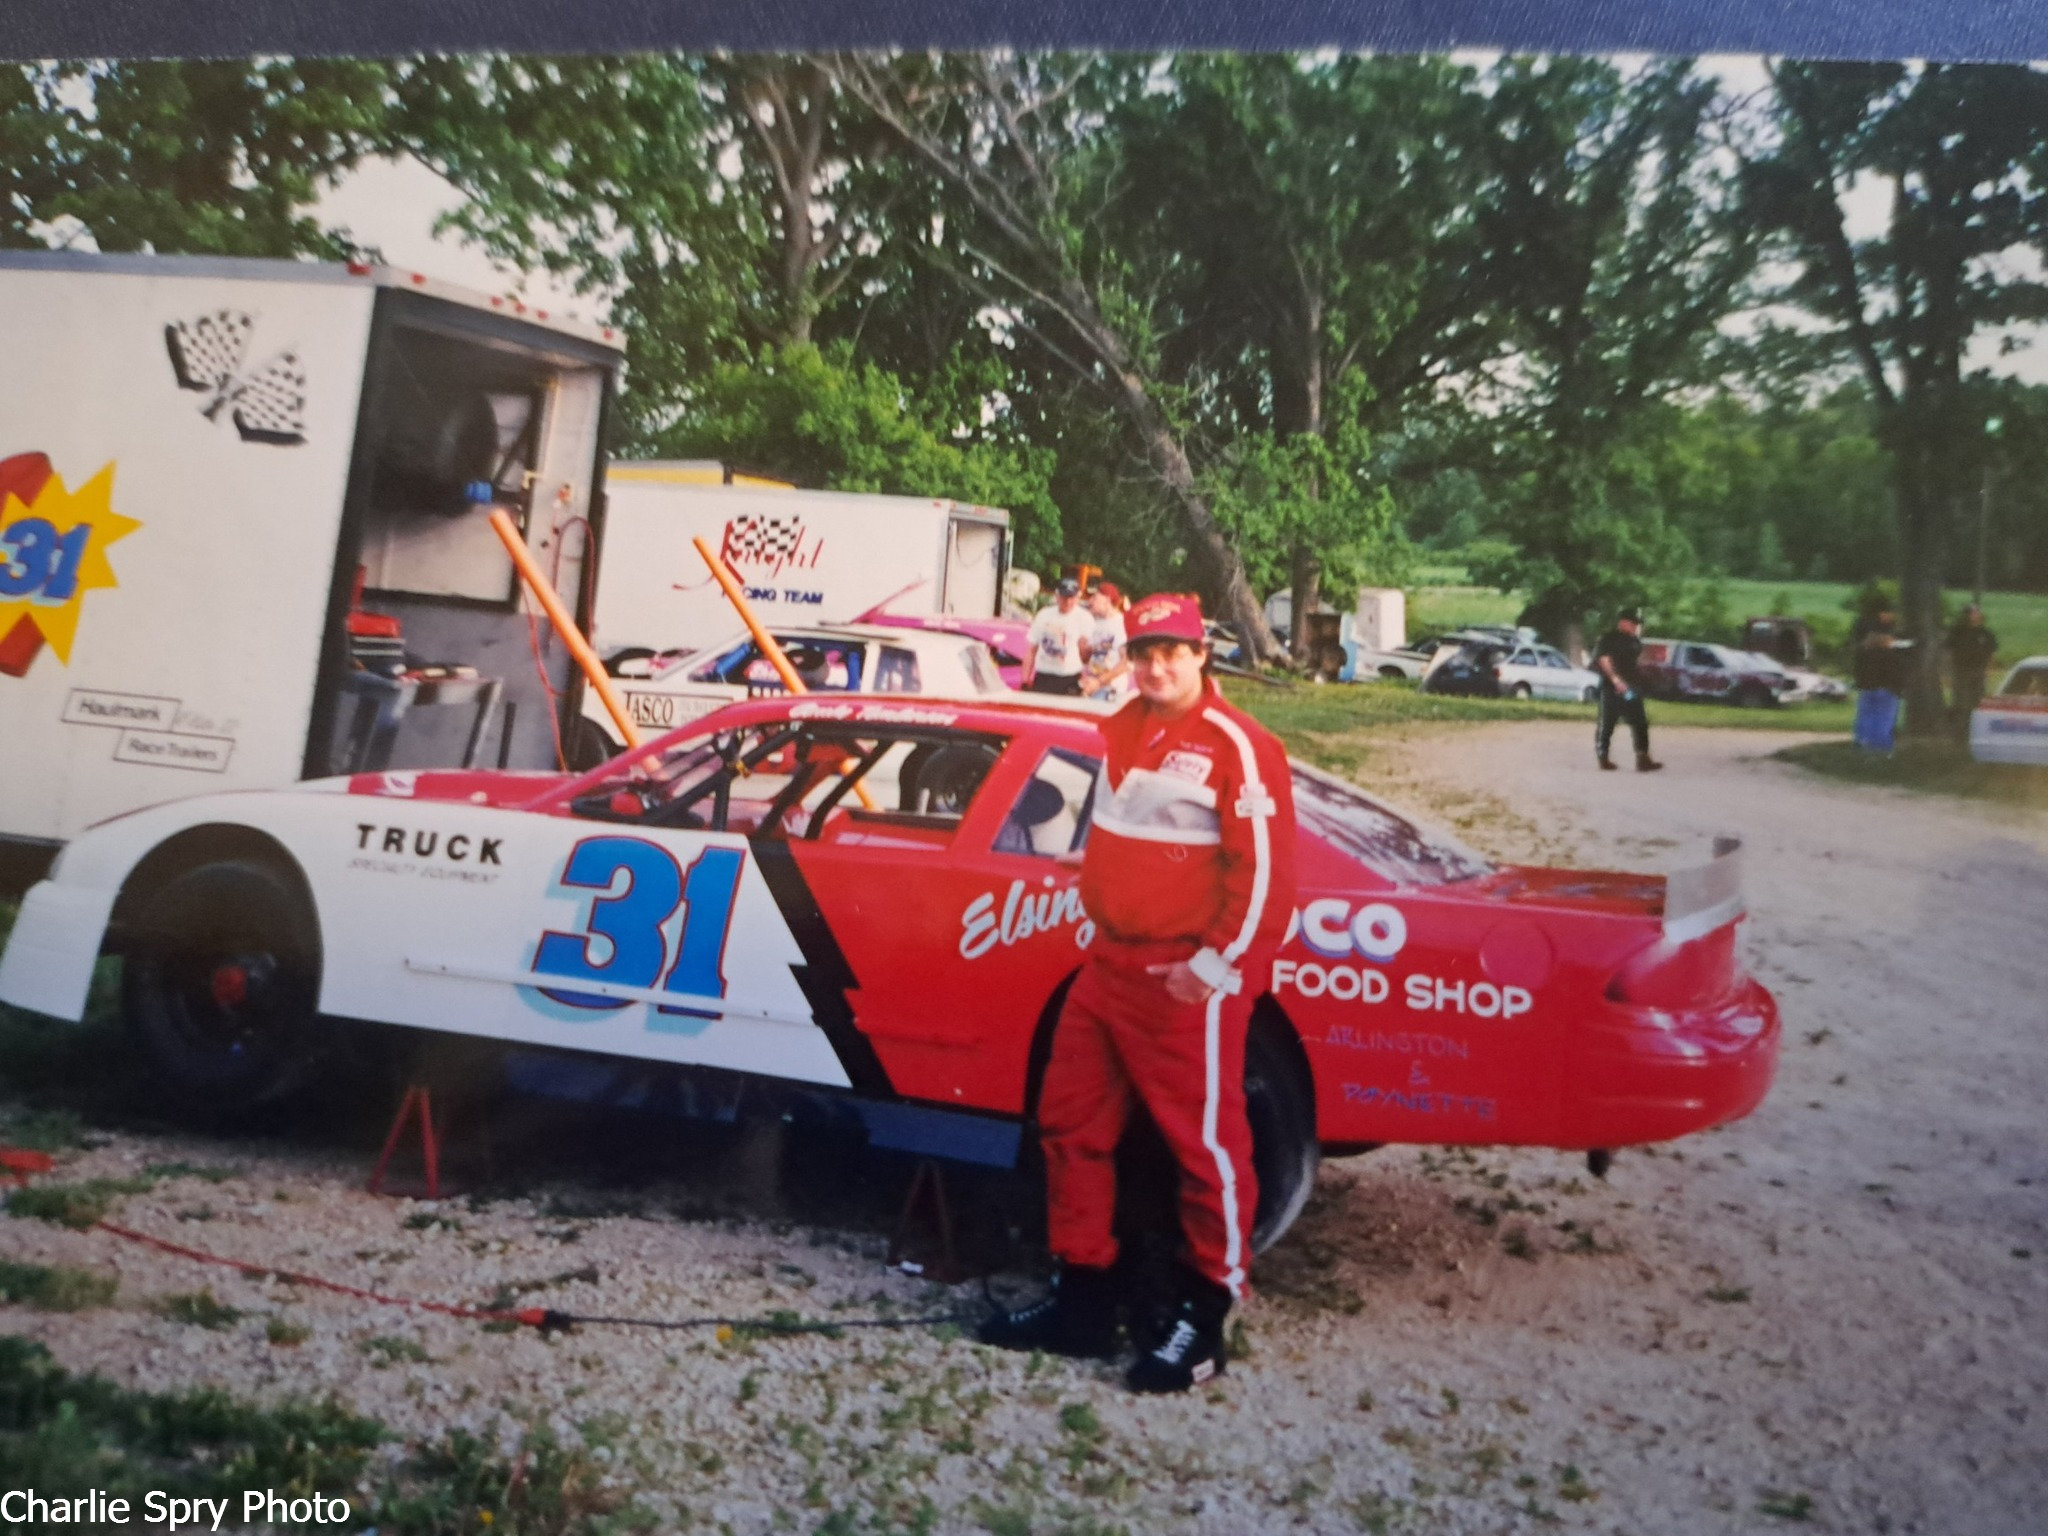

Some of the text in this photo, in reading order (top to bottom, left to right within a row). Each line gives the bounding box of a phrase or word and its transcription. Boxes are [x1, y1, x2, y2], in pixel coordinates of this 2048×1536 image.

[0, 517, 94, 606] 31
[722, 586, 824, 605] CING TEAM
[357, 823, 504, 866] TRUCK
[528, 835, 747, 1021] 31
[1281, 898, 1407, 961] CO
[1271, 959, 1533, 1020] FOOD SHOP
